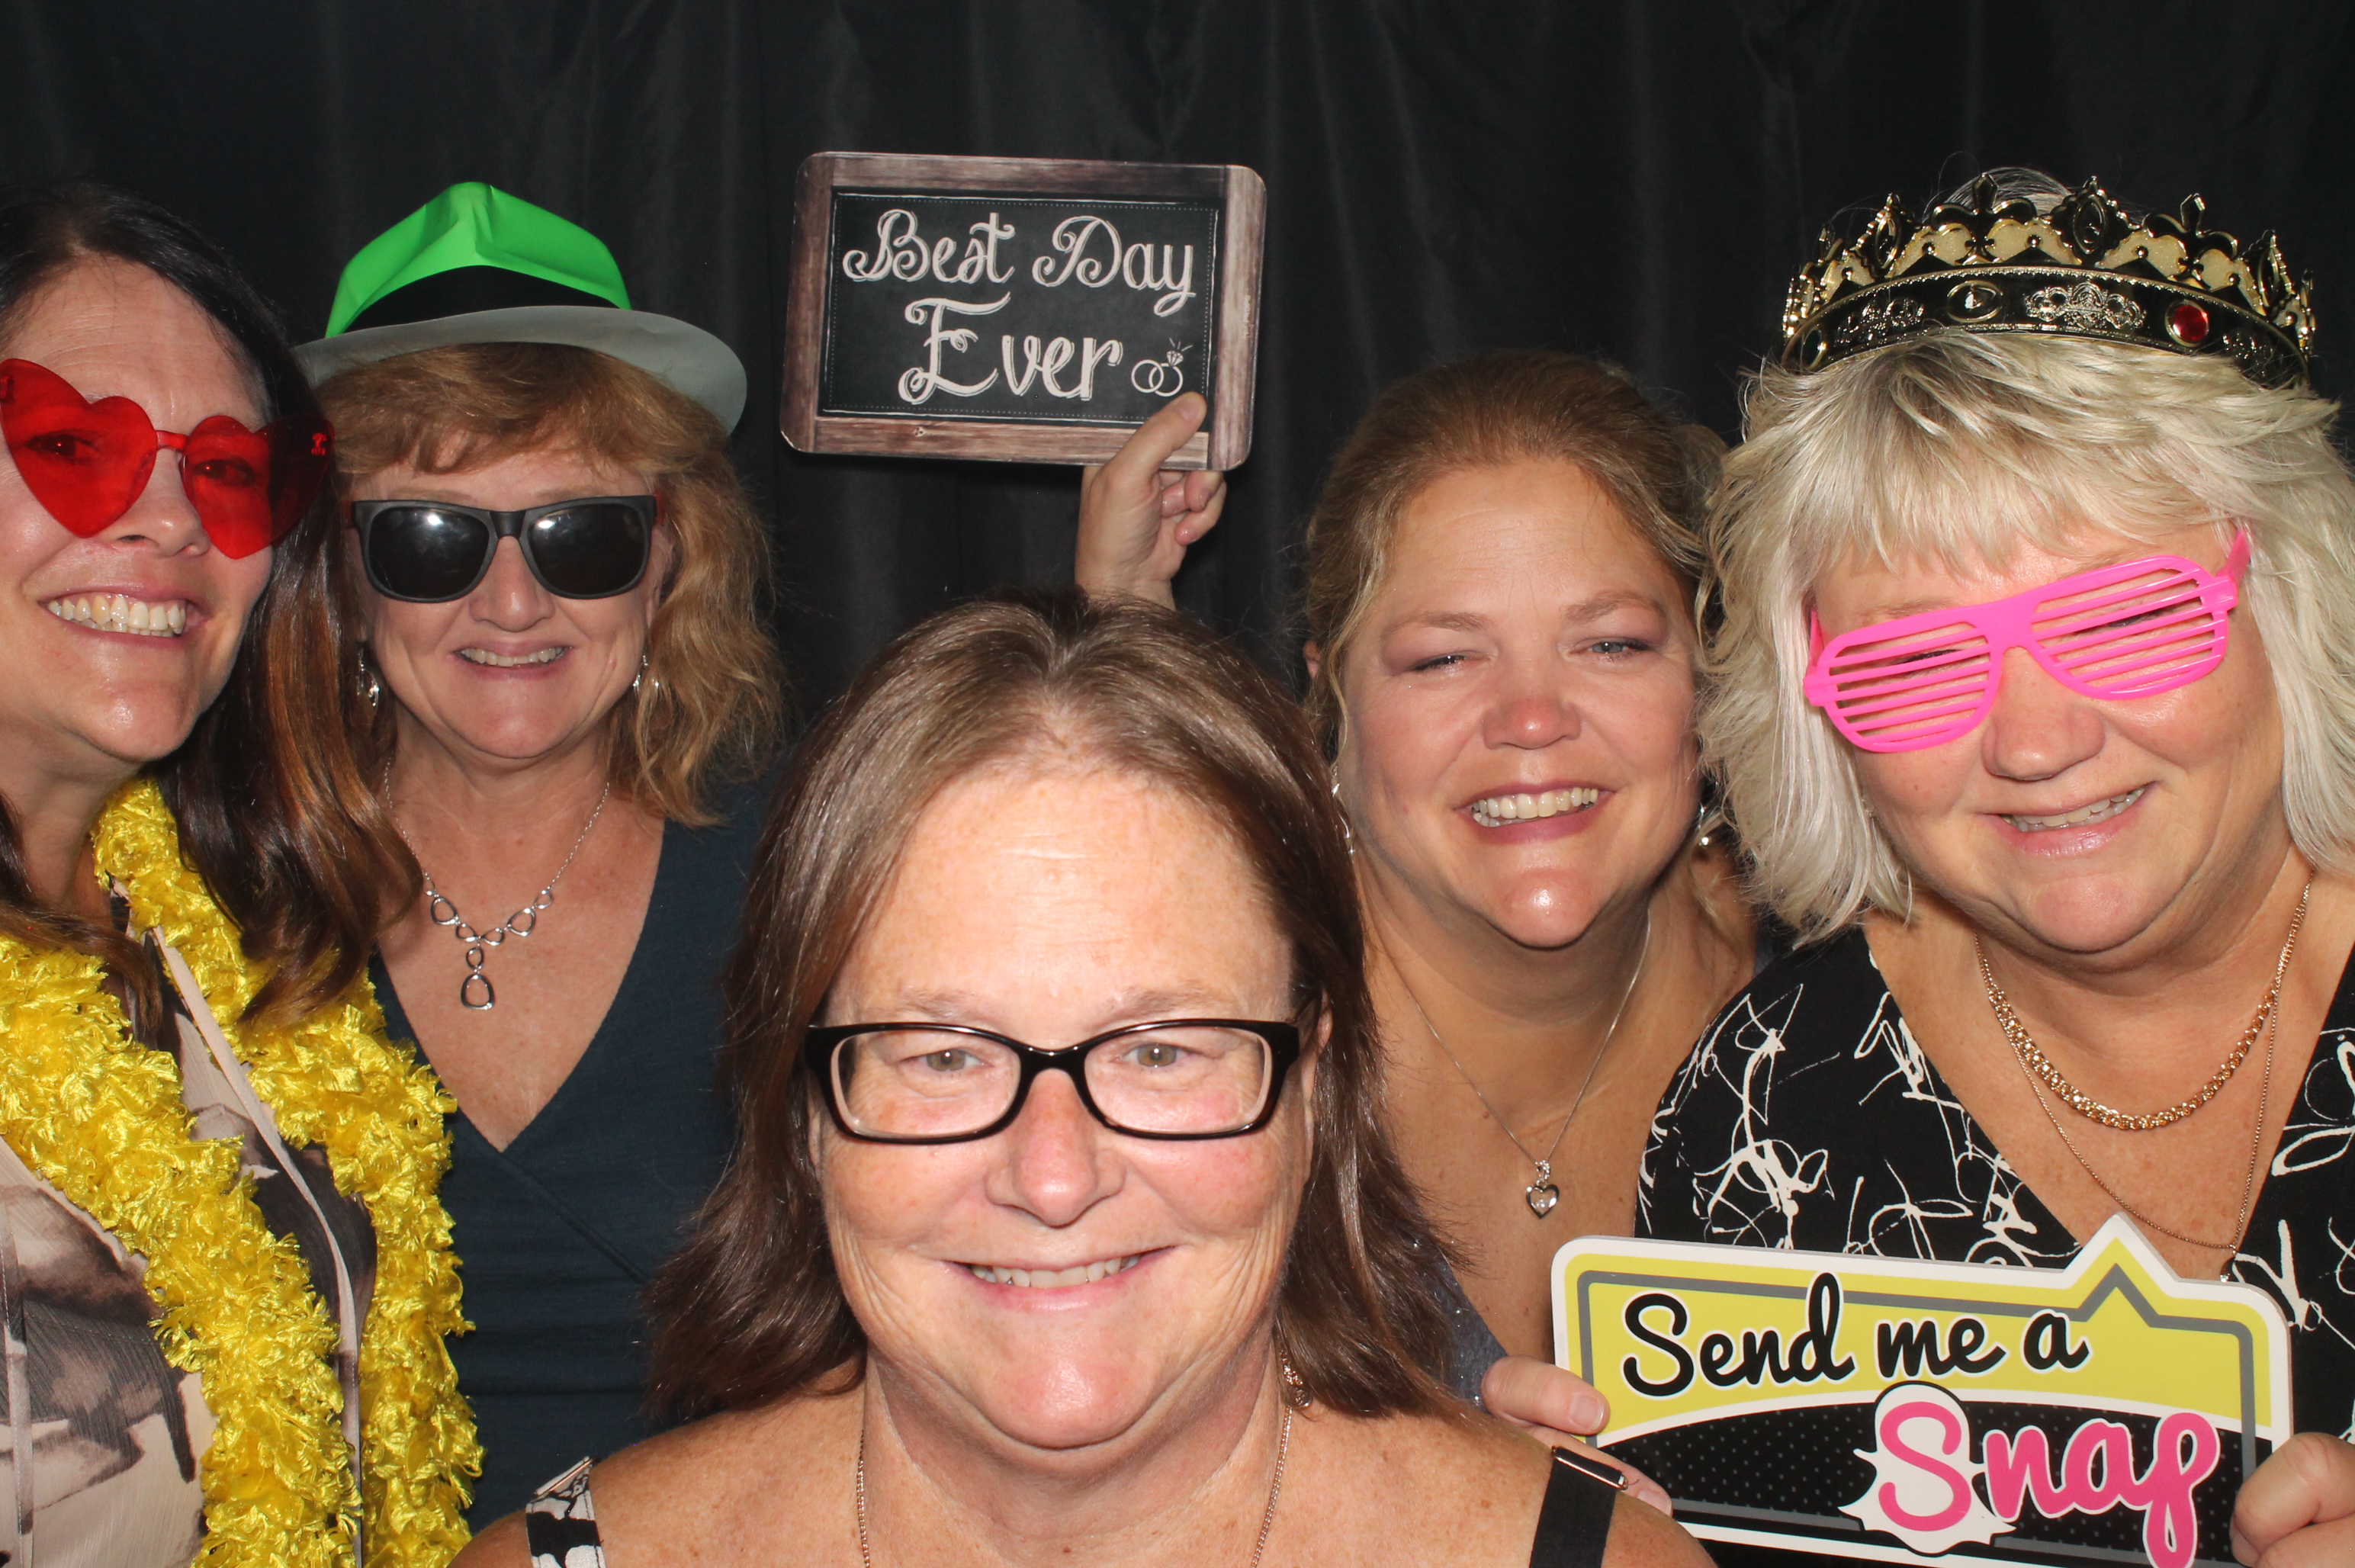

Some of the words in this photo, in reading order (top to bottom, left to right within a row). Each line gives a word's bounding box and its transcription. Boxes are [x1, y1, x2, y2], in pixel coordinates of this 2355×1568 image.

[843, 209, 1015, 284] Best
[1032, 216, 1196, 316] Day
[899, 292, 1123, 404] Ever
[1623, 1272, 1855, 1396] Send
[1877, 1319, 2006, 1377] me
[2023, 1313, 2090, 1370] a
[1878, 1401, 2219, 1568] Snap
